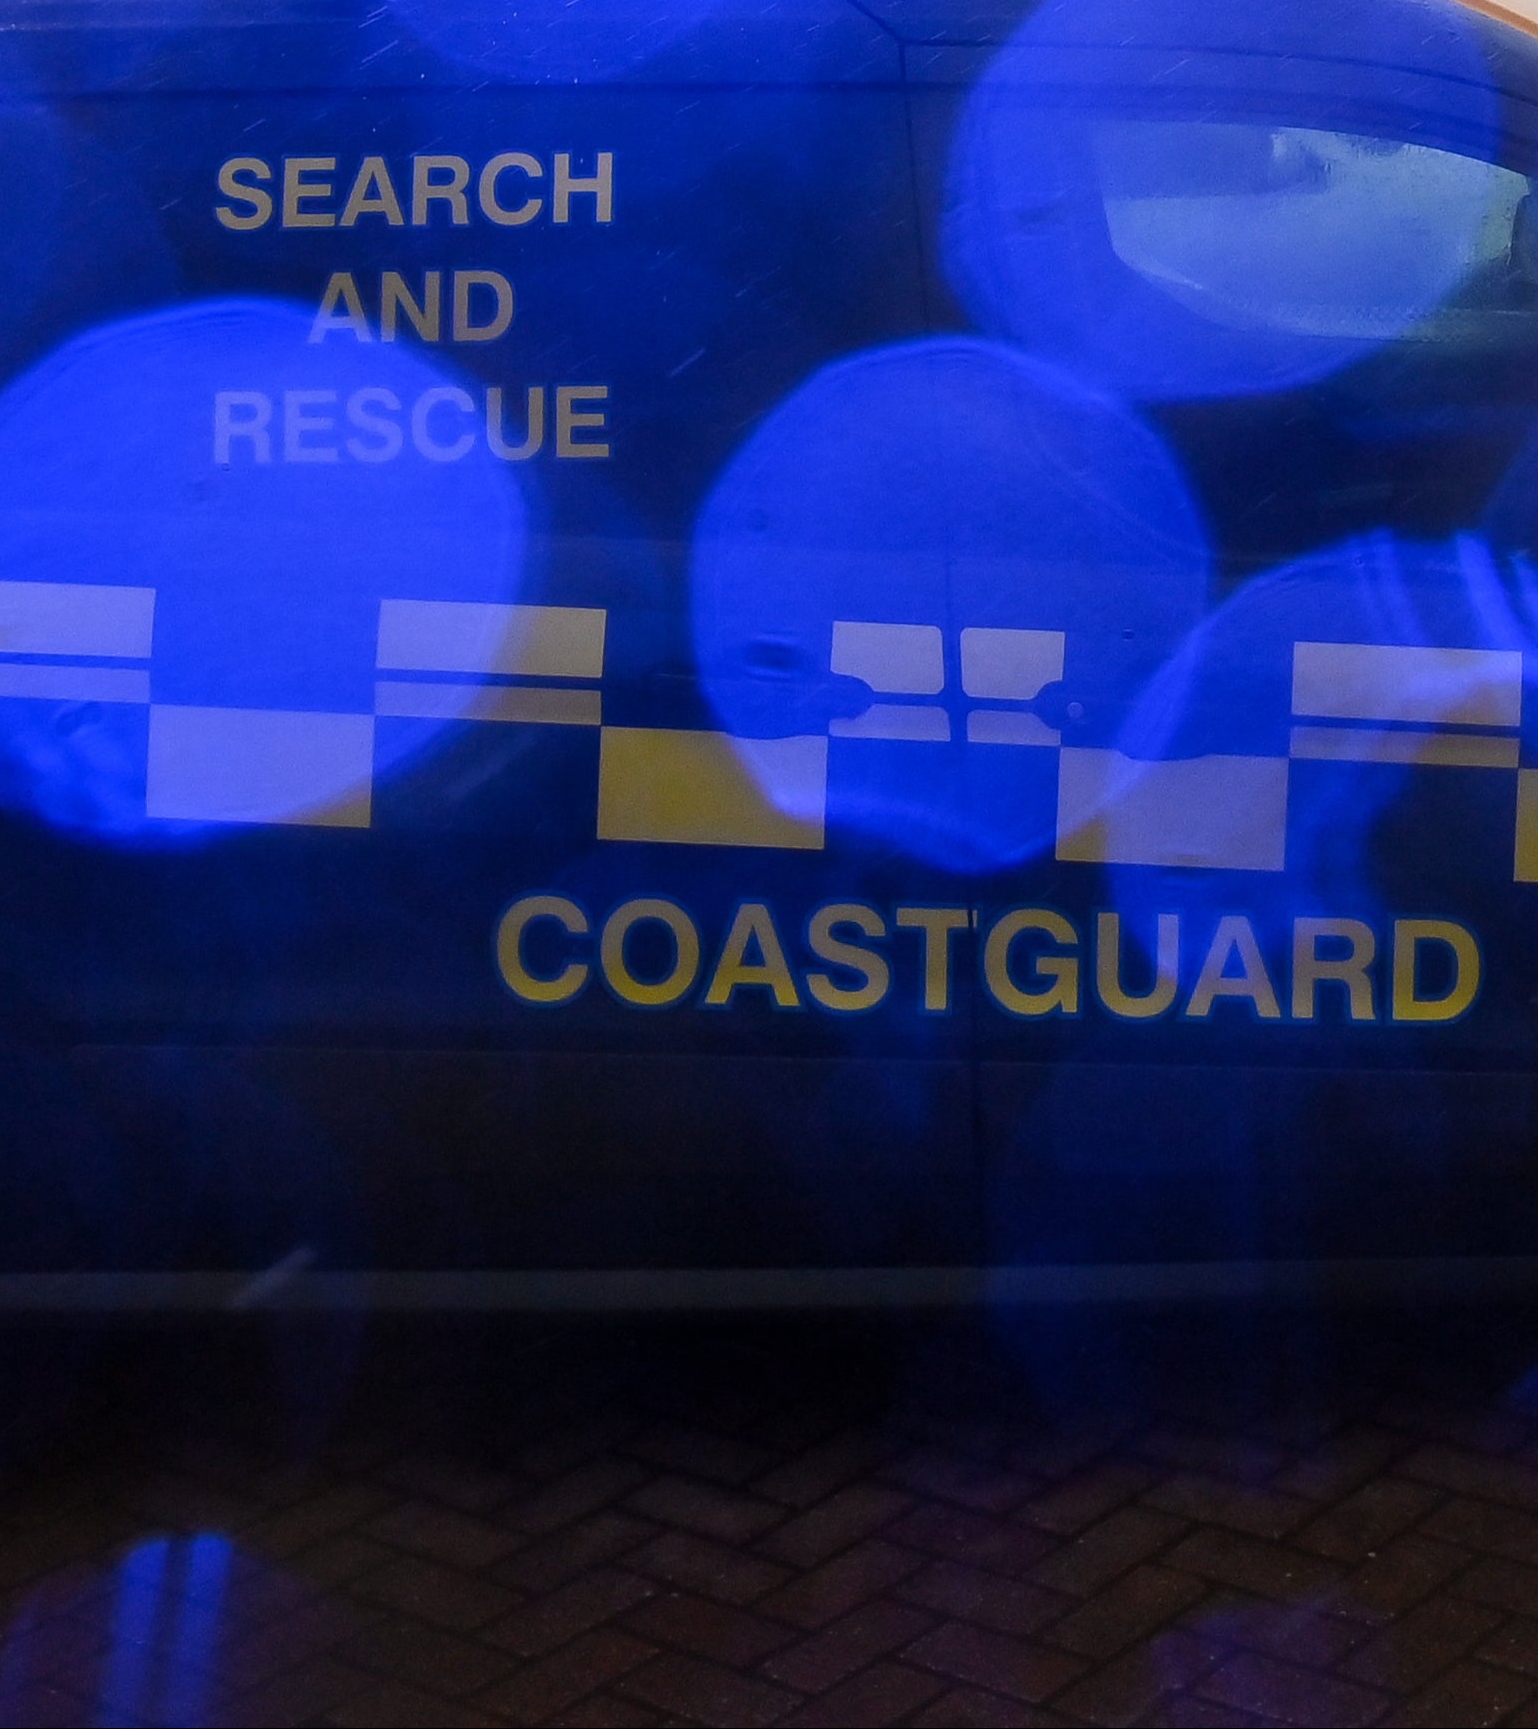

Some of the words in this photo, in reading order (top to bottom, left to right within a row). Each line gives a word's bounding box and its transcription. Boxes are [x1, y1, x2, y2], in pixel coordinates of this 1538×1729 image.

[215, 151, 615, 230] SEARCH
[307, 270, 515, 344] AND
[213, 385, 610, 465] RESCUE
[495, 894, 1482, 1024] COASTGUARD
